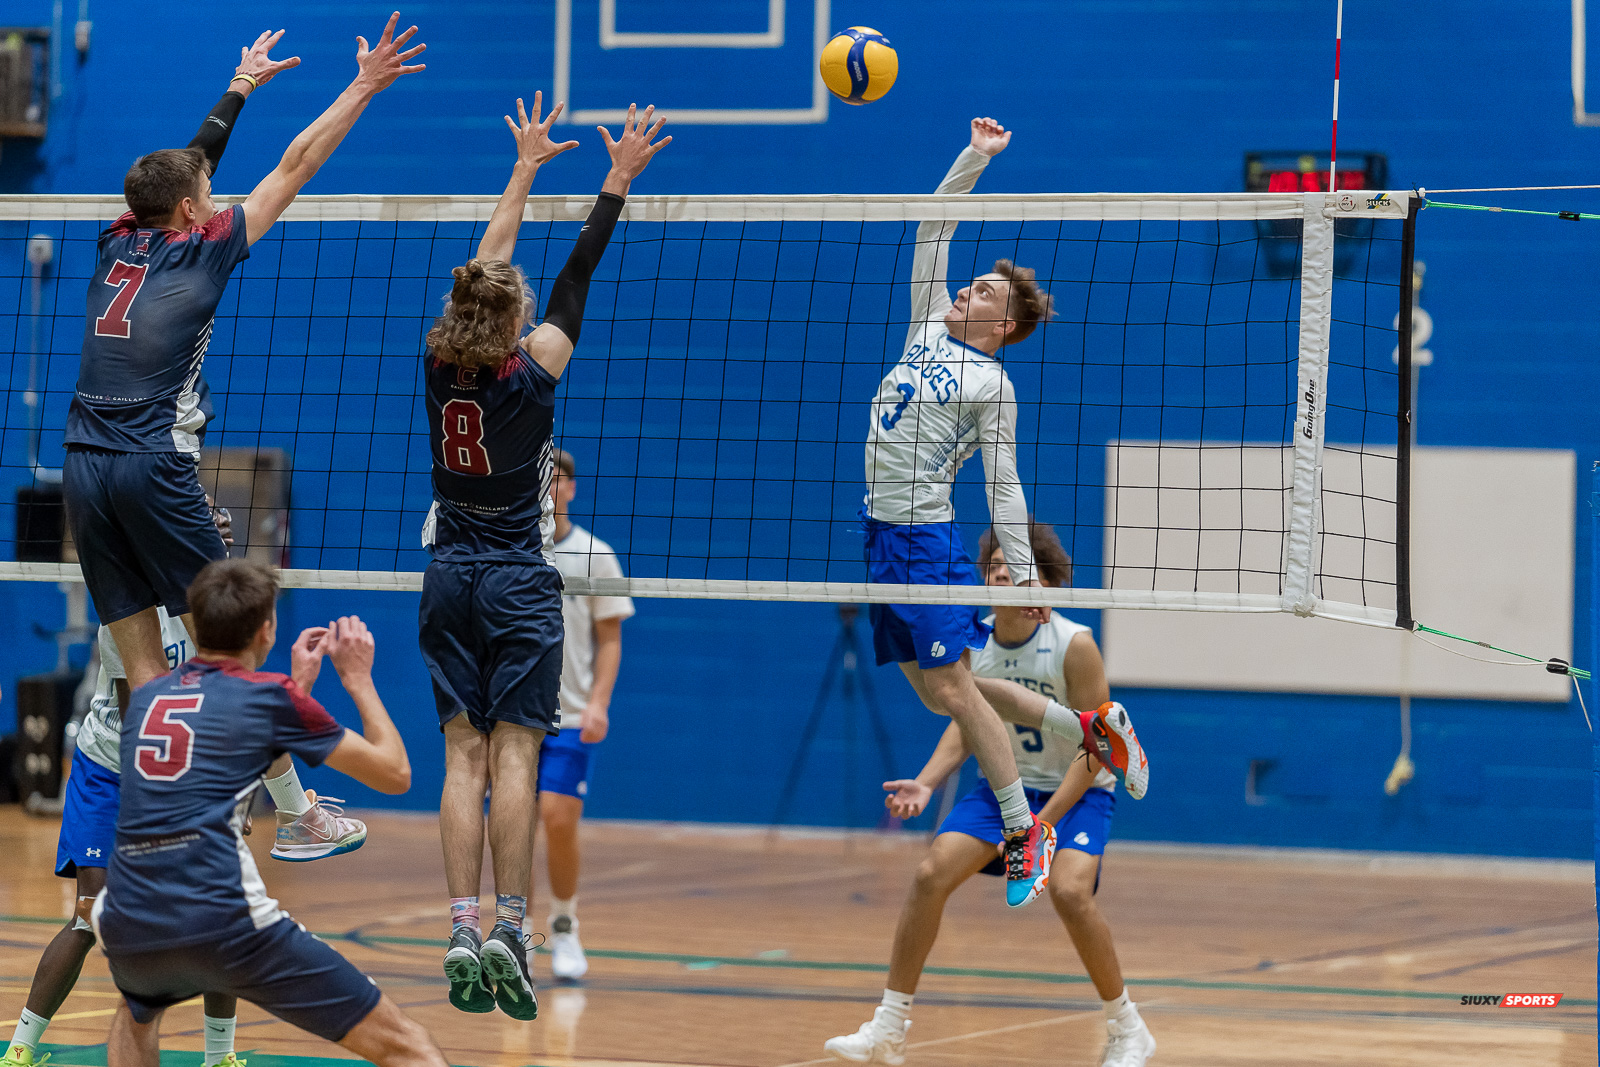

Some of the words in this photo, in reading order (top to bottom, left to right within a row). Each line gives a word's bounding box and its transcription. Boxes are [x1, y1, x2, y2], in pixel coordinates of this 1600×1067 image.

[94, 259, 149, 339] 7
[1392, 307, 1434, 366] 2
[442, 399, 492, 476] 8
[881, 383, 915, 431] 3
[1303, 379, 1316, 440] GoingOne
[134, 693, 205, 781] 5
